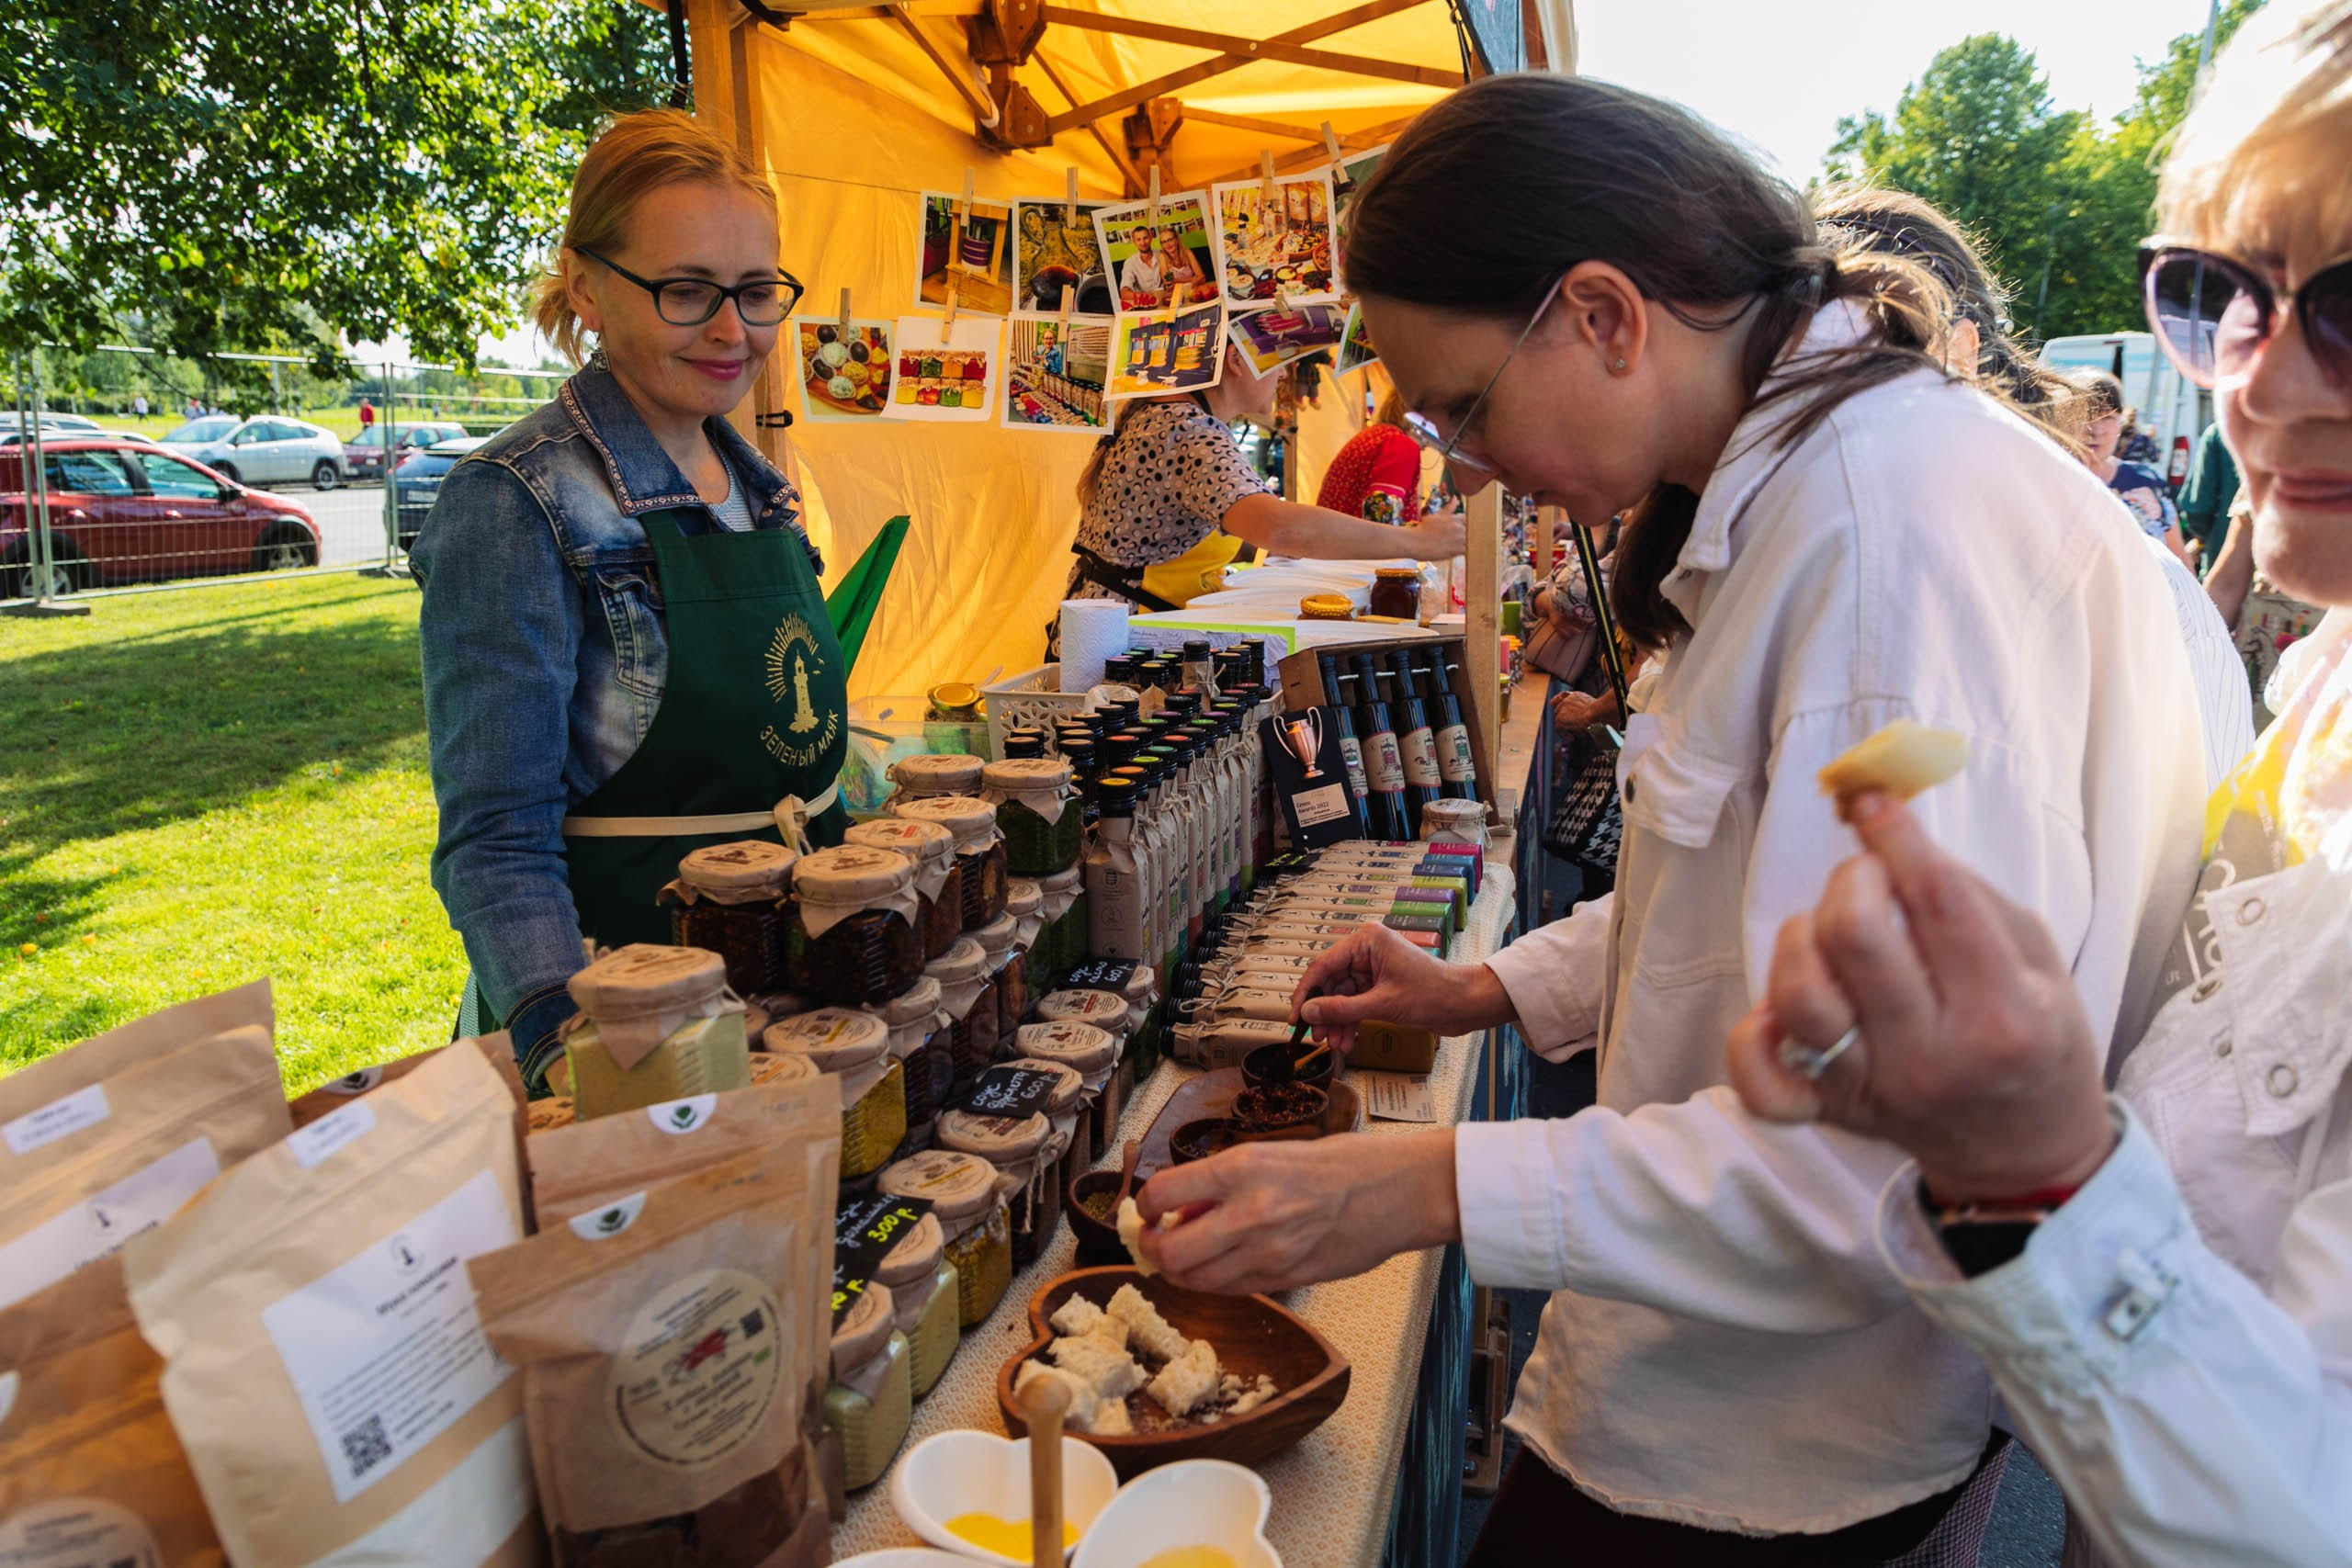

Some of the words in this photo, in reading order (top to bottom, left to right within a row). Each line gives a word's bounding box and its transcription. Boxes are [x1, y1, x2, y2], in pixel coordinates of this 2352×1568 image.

[760, 725, 816, 766] ЗЕЛЕНЫЙ
[818, 708, 839, 755] МАЯК
[972, 1083, 1002, 1106] соус
[1020, 1080, 1044, 1099] 600
[867, 1214, 899, 1242] 300
